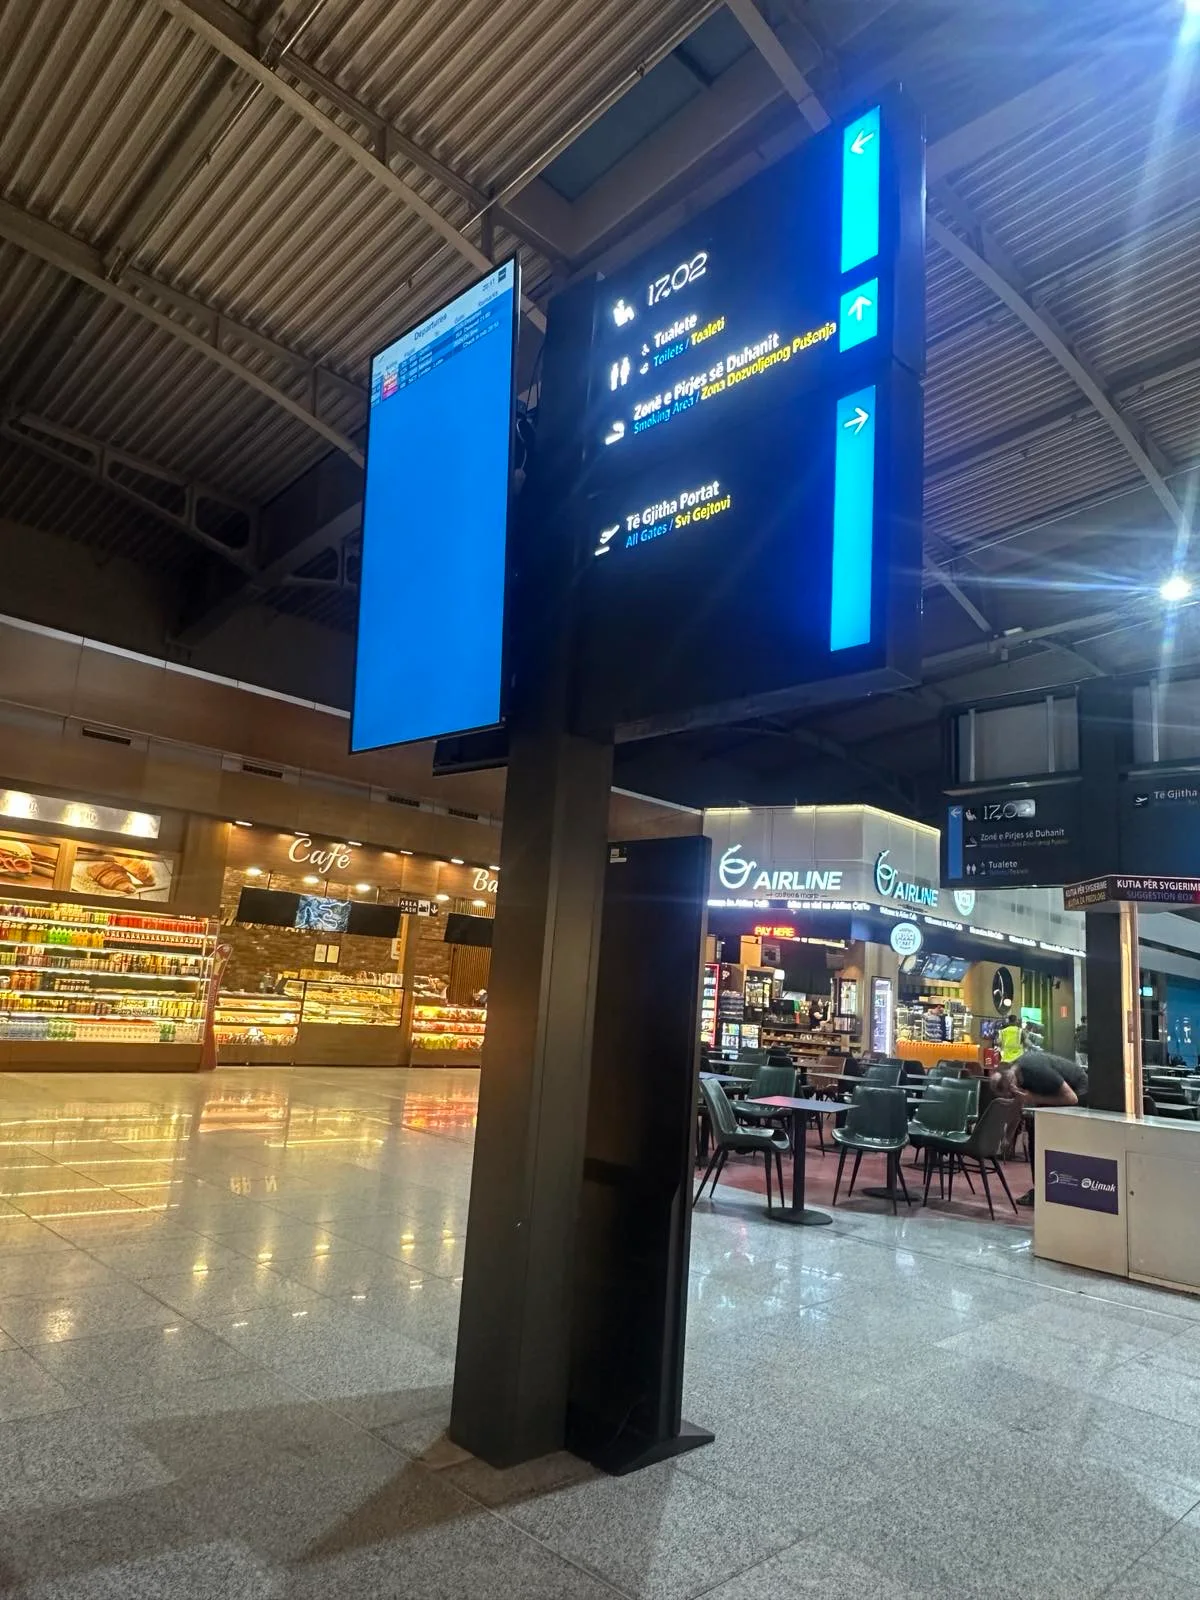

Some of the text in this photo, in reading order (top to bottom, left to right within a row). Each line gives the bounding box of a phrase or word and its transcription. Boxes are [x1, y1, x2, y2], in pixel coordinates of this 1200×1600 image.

[414, 313, 448, 341] Departures
[653, 313, 698, 348] Tualete
[653, 341, 684, 368] Toilets
[690, 316, 726, 346] Toaleti
[633, 332, 780, 421] Zonë e Pirjes së Duhanit
[633, 407, 671, 434] Smoking
[672, 393, 695, 416] Area
[700, 380, 726, 401] Zona
[727, 347, 791, 388] Dozvoljenog
[792, 321, 837, 354] Pušenja
[626, 480, 720, 531] Të Gjitha Portat
[625, 532, 639, 549] All
[640, 522, 668, 542] Gates
[675, 511, 691, 529] Svi
[692, 494, 731, 522] Gejtovi
[1167, 788, 1198, 800] Gjitha
[1035, 828, 1065, 838] Duhanit
[288, 837, 352, 874] Café
[988, 861, 1018, 869] Tualete
[753, 870, 843, 890] AIRLINE
[893, 880, 939, 907] AIRLINE
[1116, 879, 1141, 889] KUTIA
[1143, 878, 1158, 889] PËR
[1126, 890, 1194, 901] SUGGESTION BOX
[754, 926, 795, 937] PAY HERE
[1090, 1180, 1116, 1192] Limak
